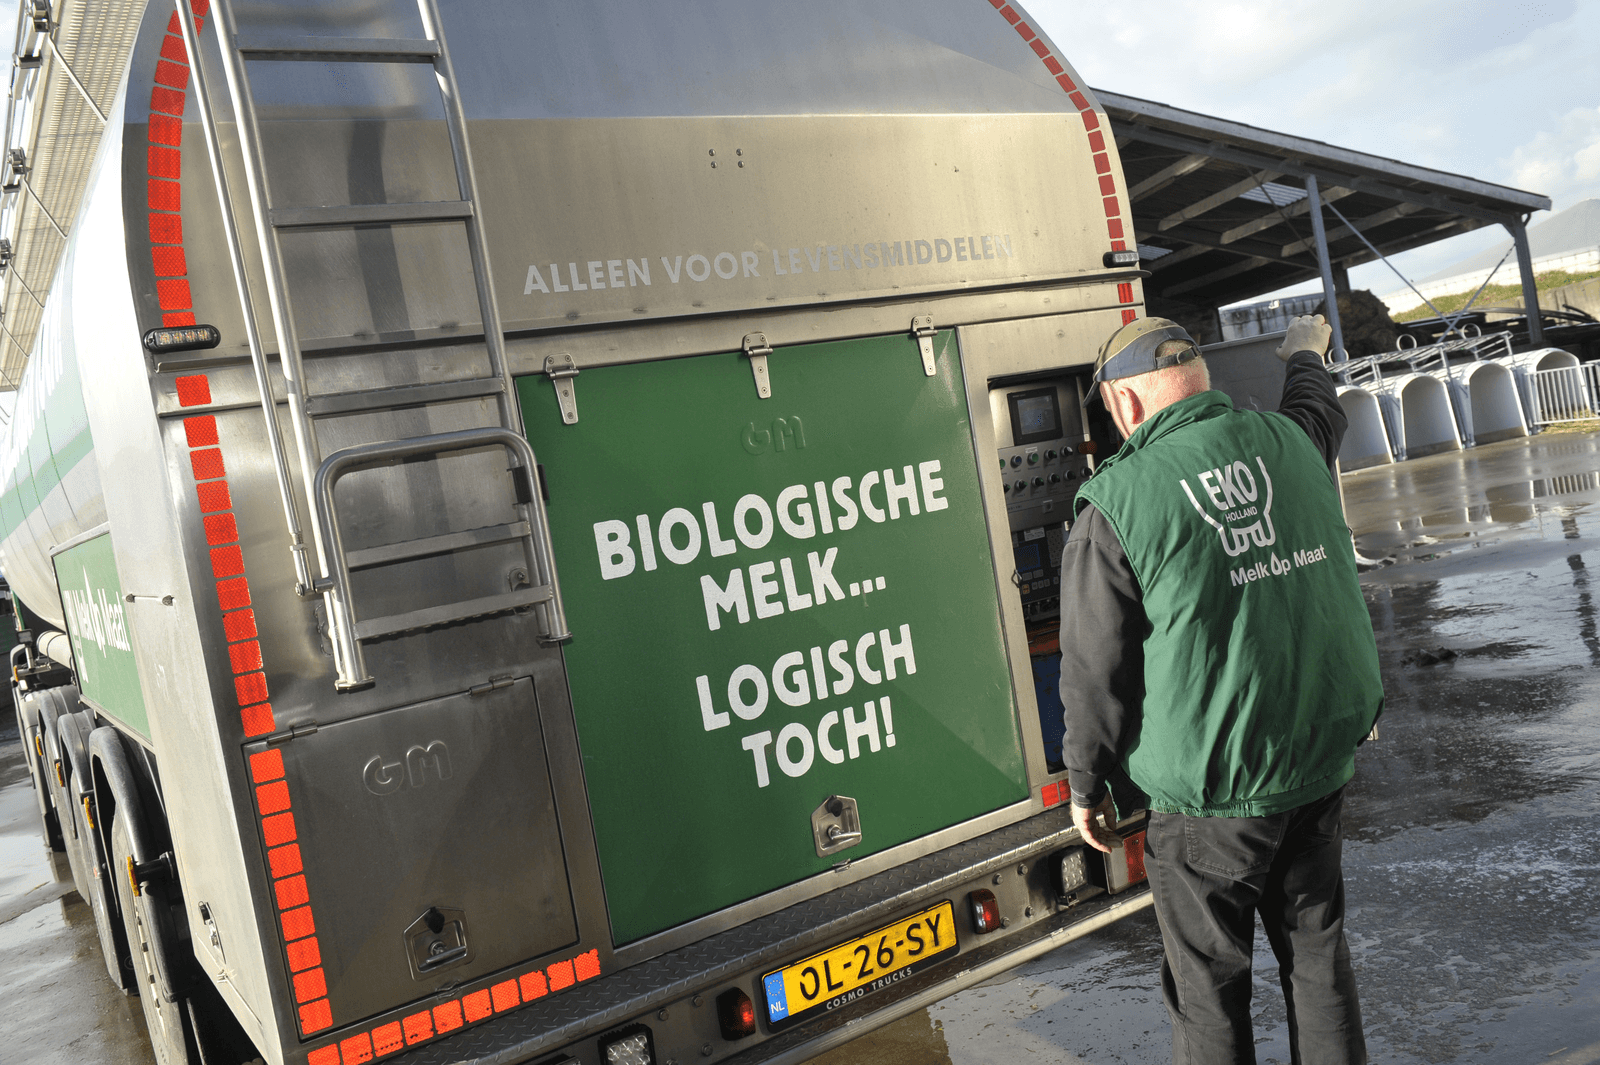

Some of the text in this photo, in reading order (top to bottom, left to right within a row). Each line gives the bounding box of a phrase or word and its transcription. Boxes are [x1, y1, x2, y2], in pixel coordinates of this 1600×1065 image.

[523, 234, 1014, 295] ALLEEN VOOR LEVENSMIDDELEN
[741, 415, 806, 456] GM
[1197, 460, 1258, 511] EKO
[593, 459, 949, 581] BIOLOGISCHE
[1225, 506, 1258, 523] HOLLAND
[700, 546, 886, 631] MELK...
[1230, 544, 1327, 587] Melk Op Maat
[696, 623, 917, 731] LOGISCH
[363, 740, 453, 796] GM
[741, 696, 896, 788] TOCH!
[800, 913, 941, 1000] OL-26-SY
[770, 1000, 785, 1014] NL
[826, 967, 912, 1010] COSMO TRUCKS
